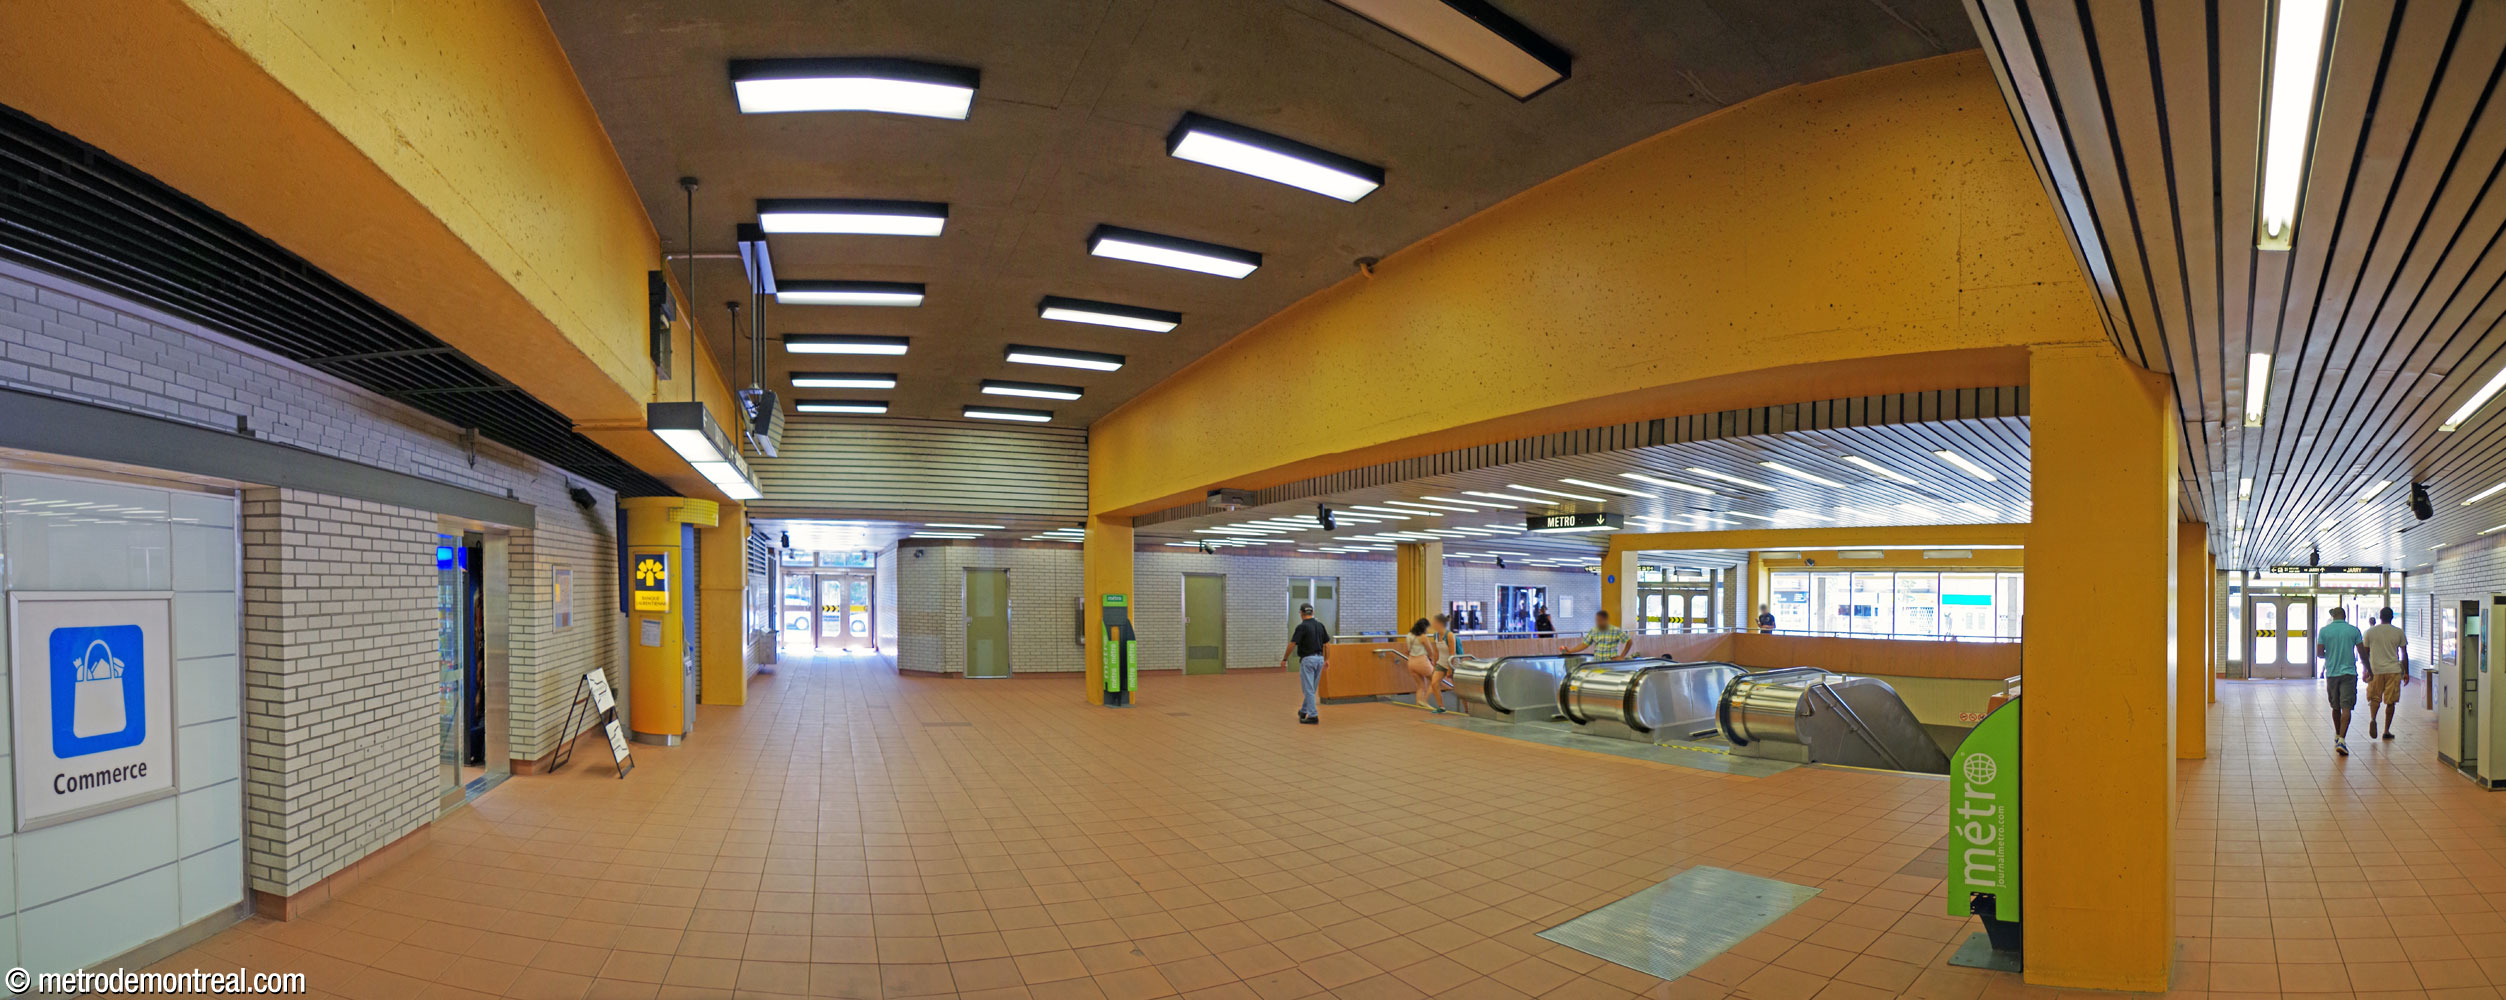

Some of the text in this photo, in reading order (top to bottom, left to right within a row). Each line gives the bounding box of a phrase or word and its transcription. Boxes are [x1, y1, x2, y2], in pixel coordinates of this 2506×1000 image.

[1547, 516, 1576, 527] METRO
[54, 762, 147, 795] Commerce
[1997, 806, 2006, 888] journalmetro.com
